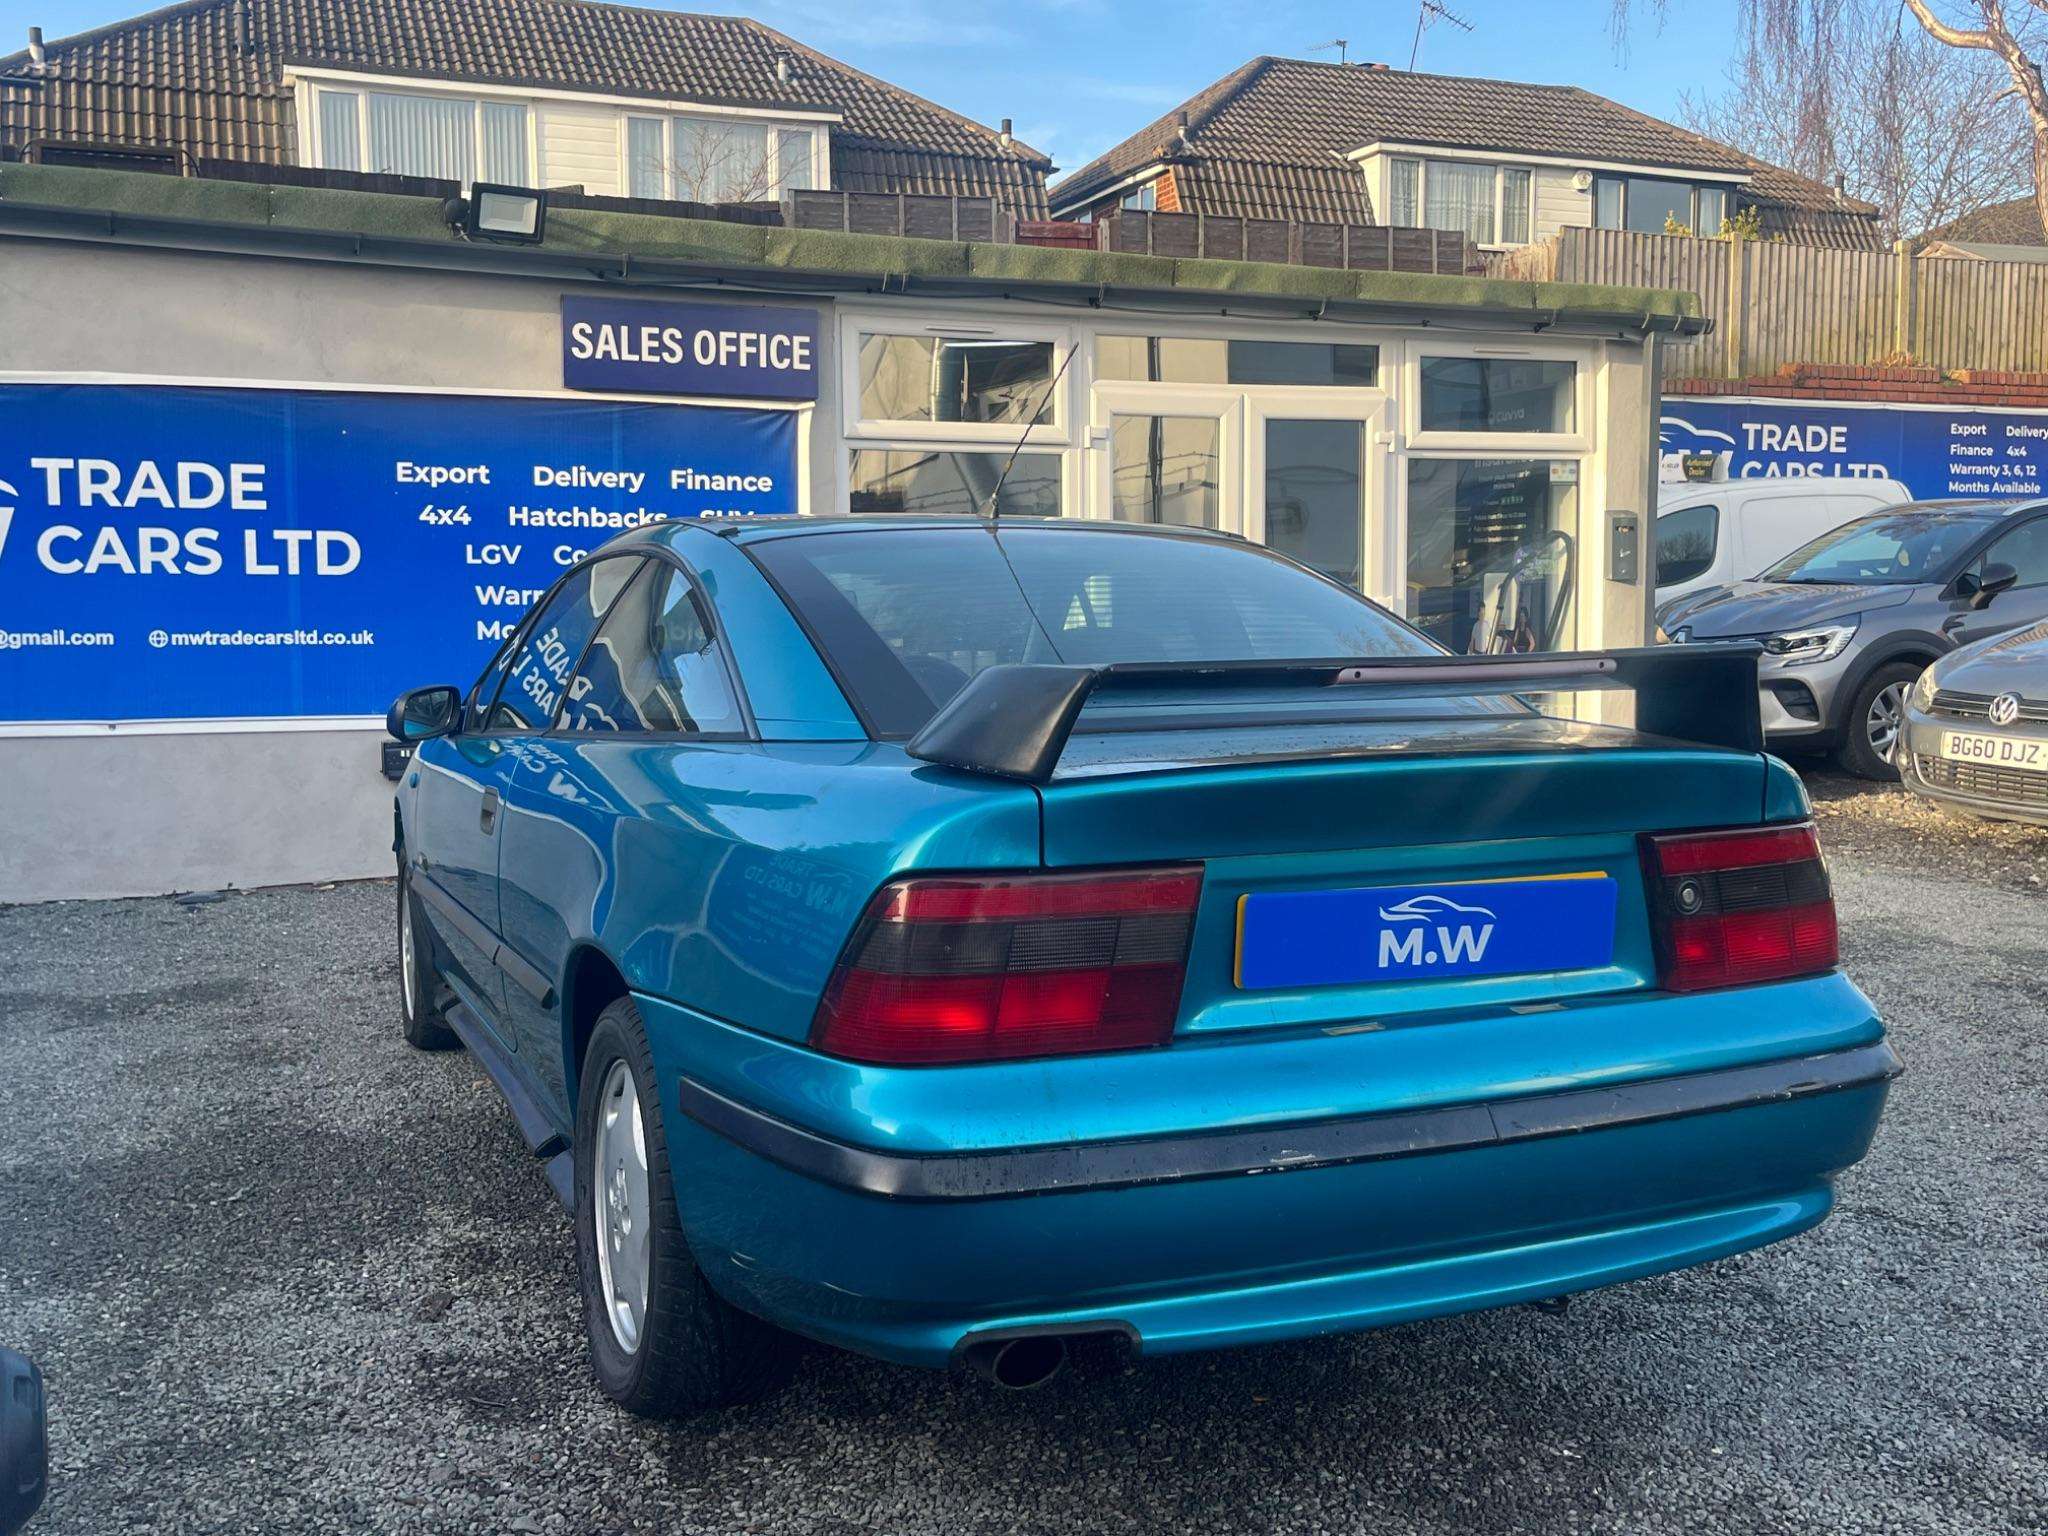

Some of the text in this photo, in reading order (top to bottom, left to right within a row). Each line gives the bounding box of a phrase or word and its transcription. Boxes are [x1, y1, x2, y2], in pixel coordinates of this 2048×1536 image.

[571, 322, 812, 371] SALES OFFICE
[1741, 422, 1848, 453] TRADE
[1950, 423, 2048, 440] Export Delivery
[1950, 443, 2028, 457] Finance 4x4
[396, 462, 773, 493] Export Delivery Finance
[1949, 463, 2037, 478] Warranty 3, 6, 12
[30, 457, 267, 510] TRADE
[1948, 481, 2041, 494] Months Available
[418, 505, 472, 526] 4x4
[37, 525, 223, 575] CARS
[244, 529, 361, 576] LTD
[466, 544, 522, 565] LGV
[171, 630, 375, 647] mwtradecarsltd.co.uk
[1951, 736, 2041, 765] BG60 DJZ
